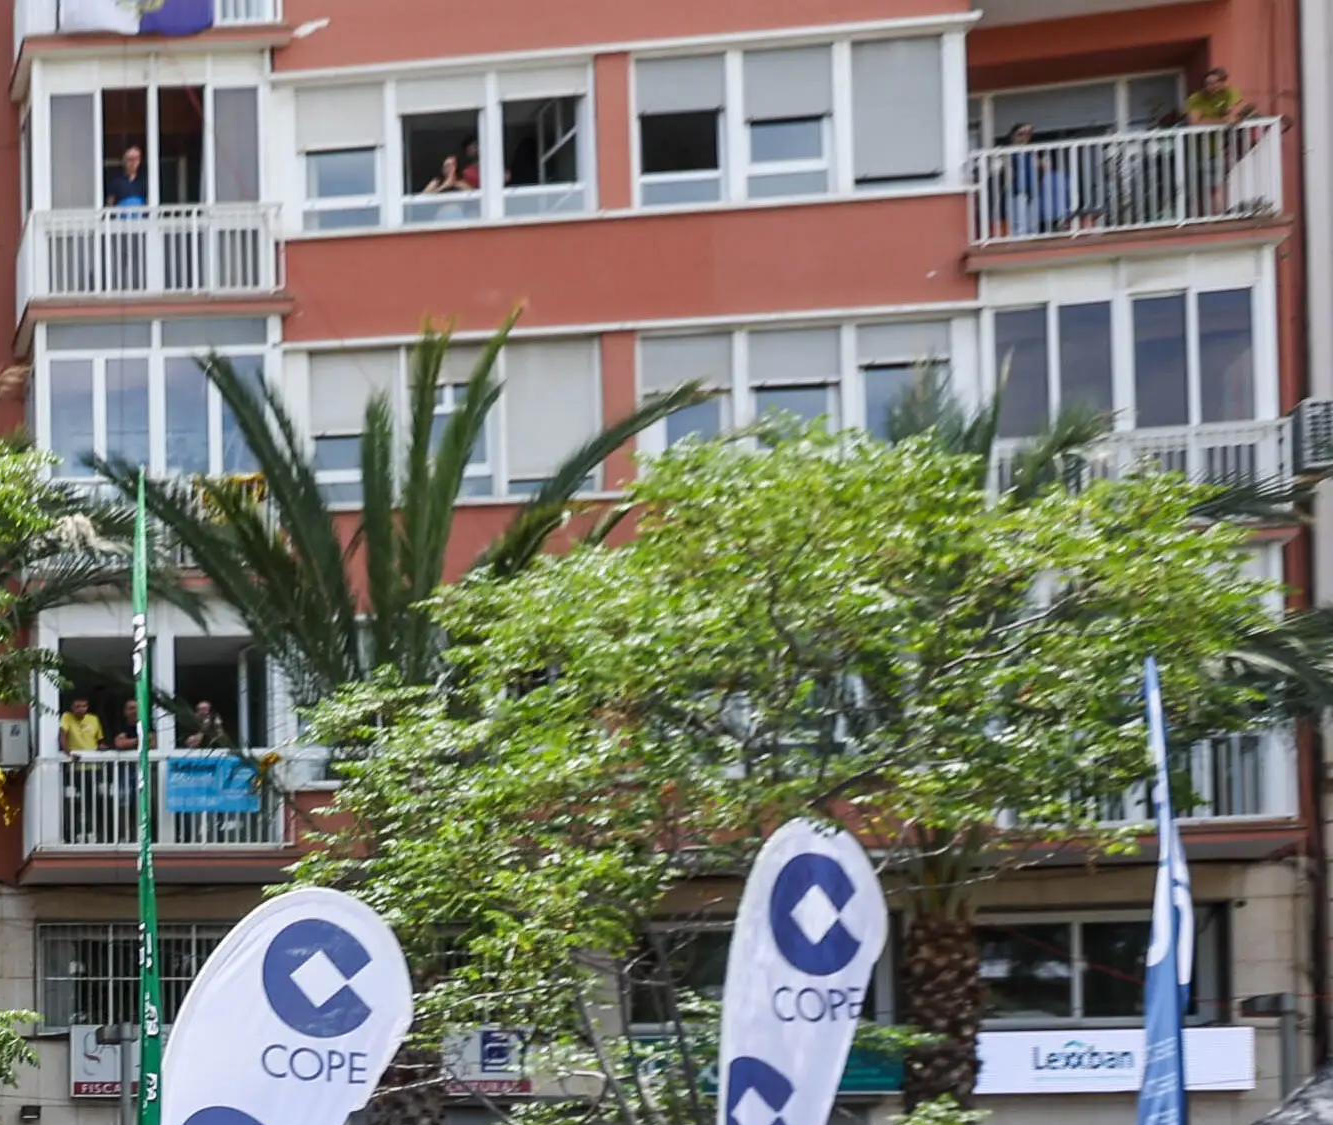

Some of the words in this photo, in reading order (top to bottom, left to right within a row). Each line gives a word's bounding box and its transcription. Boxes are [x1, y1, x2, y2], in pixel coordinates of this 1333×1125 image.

[772, 986, 863, 1023] COPE
[261, 1044, 368, 1084] COPE
[1033, 1046, 1133, 1070] Lexxban
